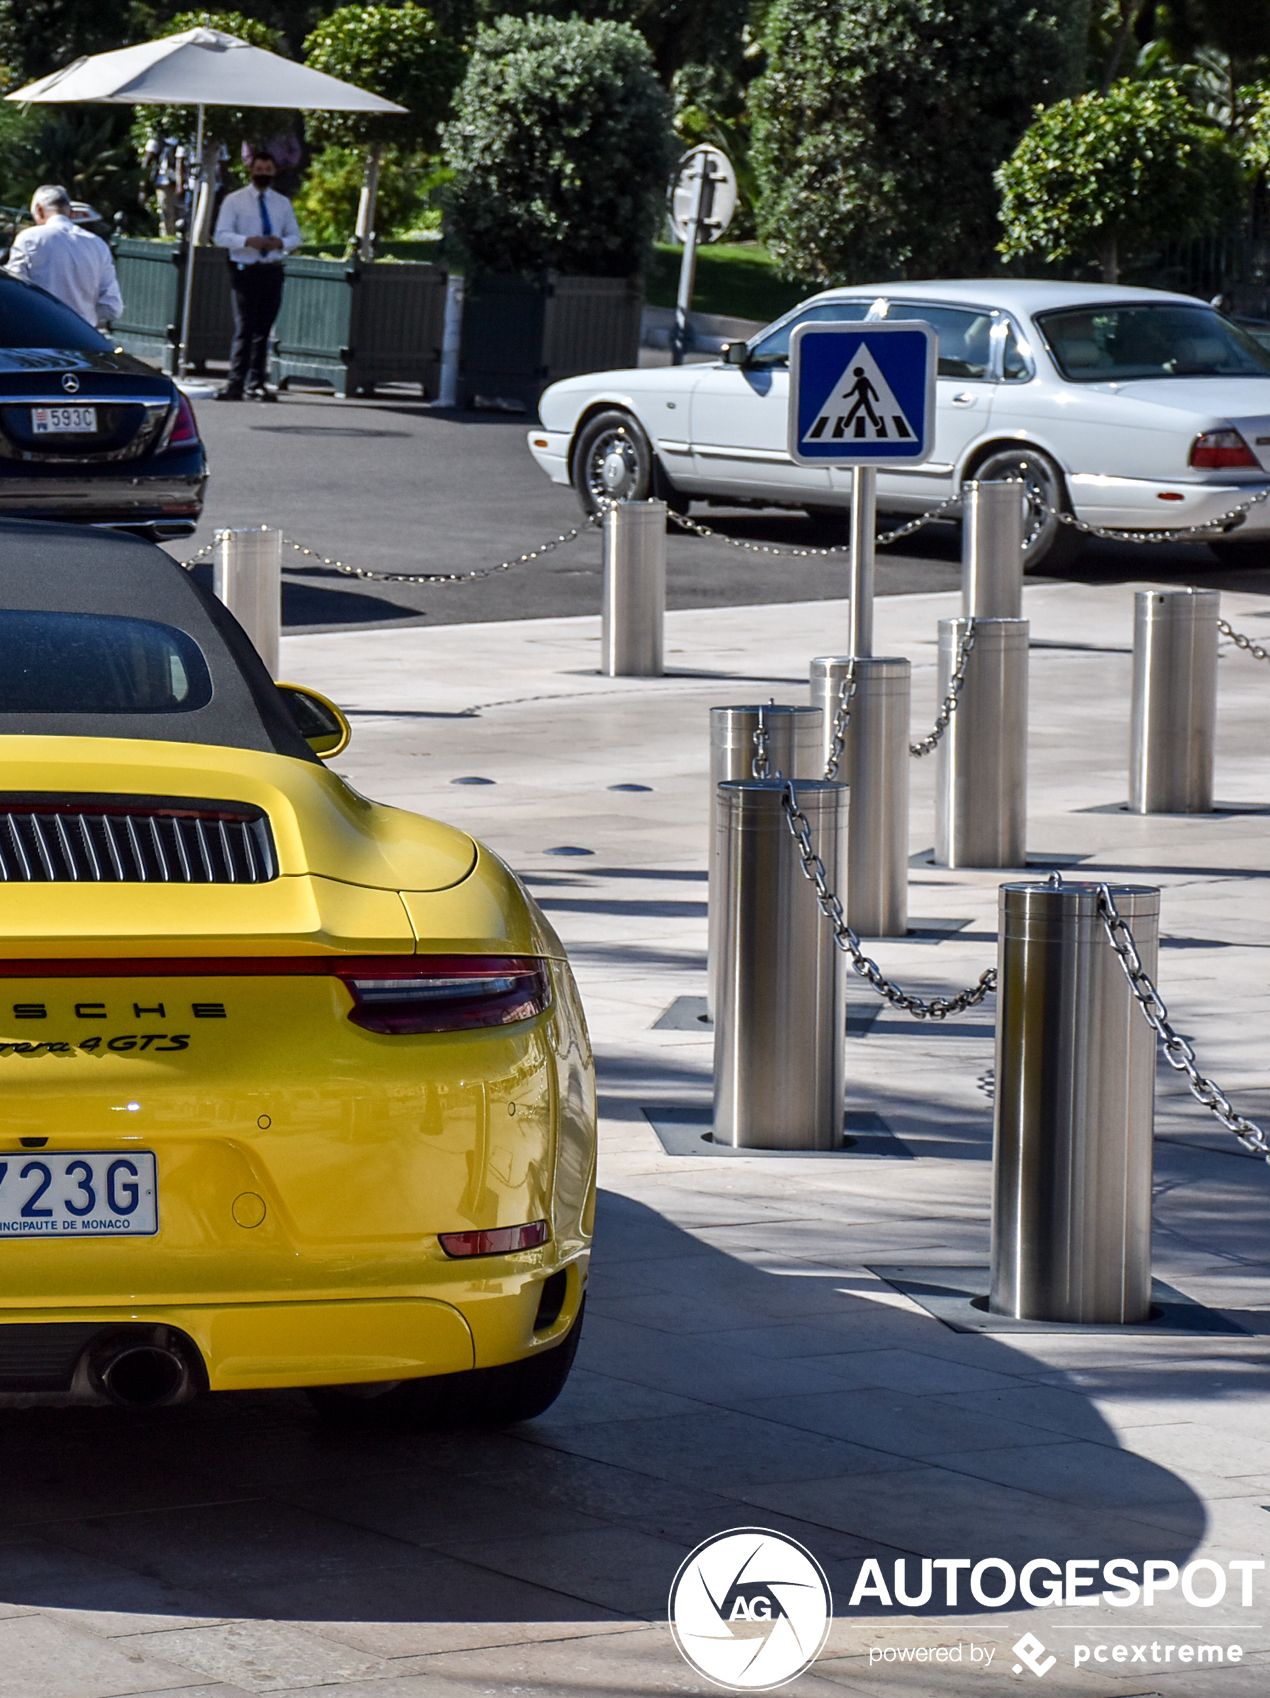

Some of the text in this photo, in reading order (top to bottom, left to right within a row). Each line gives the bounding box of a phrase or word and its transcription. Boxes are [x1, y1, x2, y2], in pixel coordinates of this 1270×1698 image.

[51, 409, 92, 427] 593C
[77, 1036, 102, 1050] 4
[106, 1034, 191, 1051] GTS
[62, 1221, 77, 1230] DE
[81, 1219, 131, 1229] MONACO
